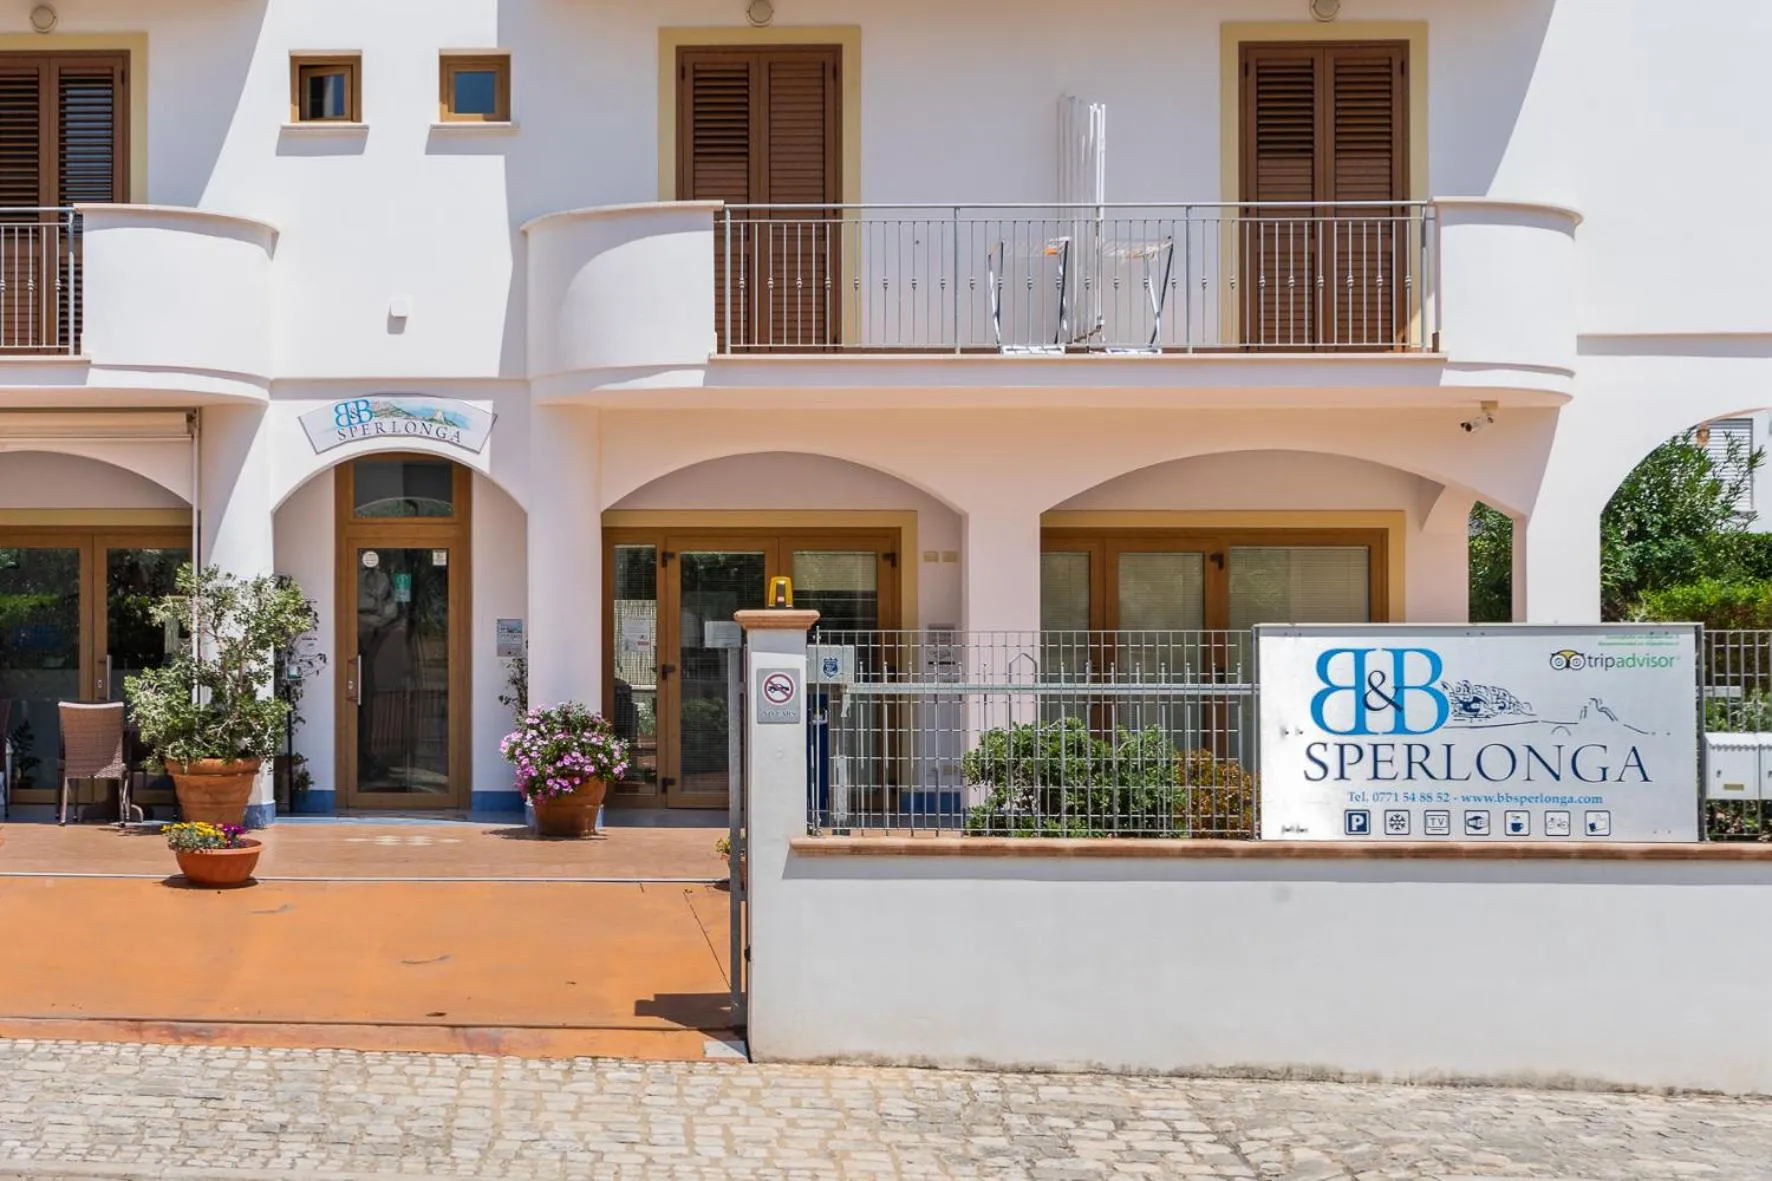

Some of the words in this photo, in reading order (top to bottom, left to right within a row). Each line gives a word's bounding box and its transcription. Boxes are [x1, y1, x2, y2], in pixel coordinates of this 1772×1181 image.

[334, 399, 374, 428] B&B
[337, 421, 462, 443] SPERLONGA
[1588, 653, 1675, 671] tripadvisor
[1309, 647, 1451, 736] B&B
[1303, 742, 1654, 783] SPERLONGA
[1372, 792, 1399, 803] 0771
[1403, 792, 1415, 803] 54
[1419, 792, 1433, 803] 88
[1435, 792, 1450, 803] 52
[1460, 792, 1603, 806] www.bbsperlonga.com
[1350, 814, 1365, 831] P
[1430, 817, 1445, 826] TV
